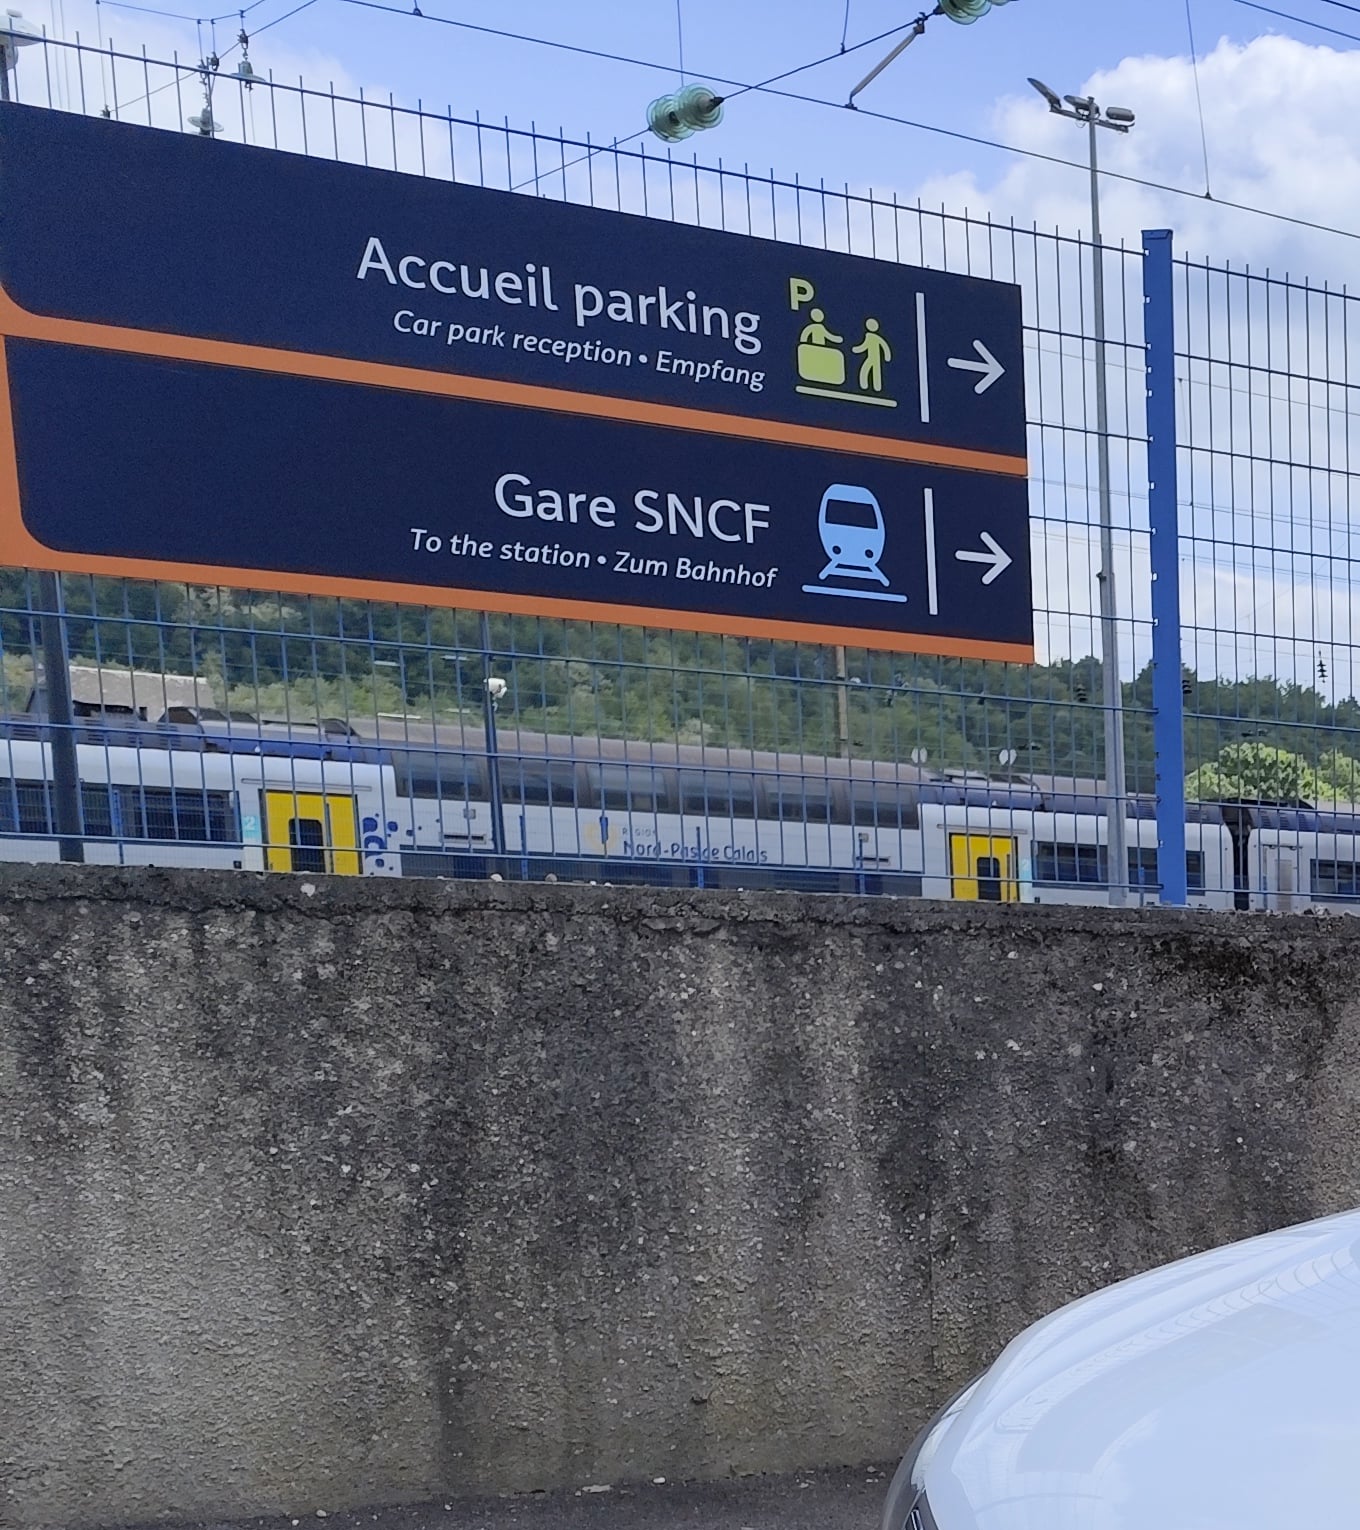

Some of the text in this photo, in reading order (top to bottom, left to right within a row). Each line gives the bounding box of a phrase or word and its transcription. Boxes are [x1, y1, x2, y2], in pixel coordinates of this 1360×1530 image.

[356, 236, 762, 355] Accueil parking
[788, 276, 815, 312] P
[393, 310, 766, 393] Car park reception Empfang
[494, 473, 771, 544] Gare SNCF
[409, 528, 779, 588] To the station Zum Bahnhof
[723, 845, 768, 862] Calas
